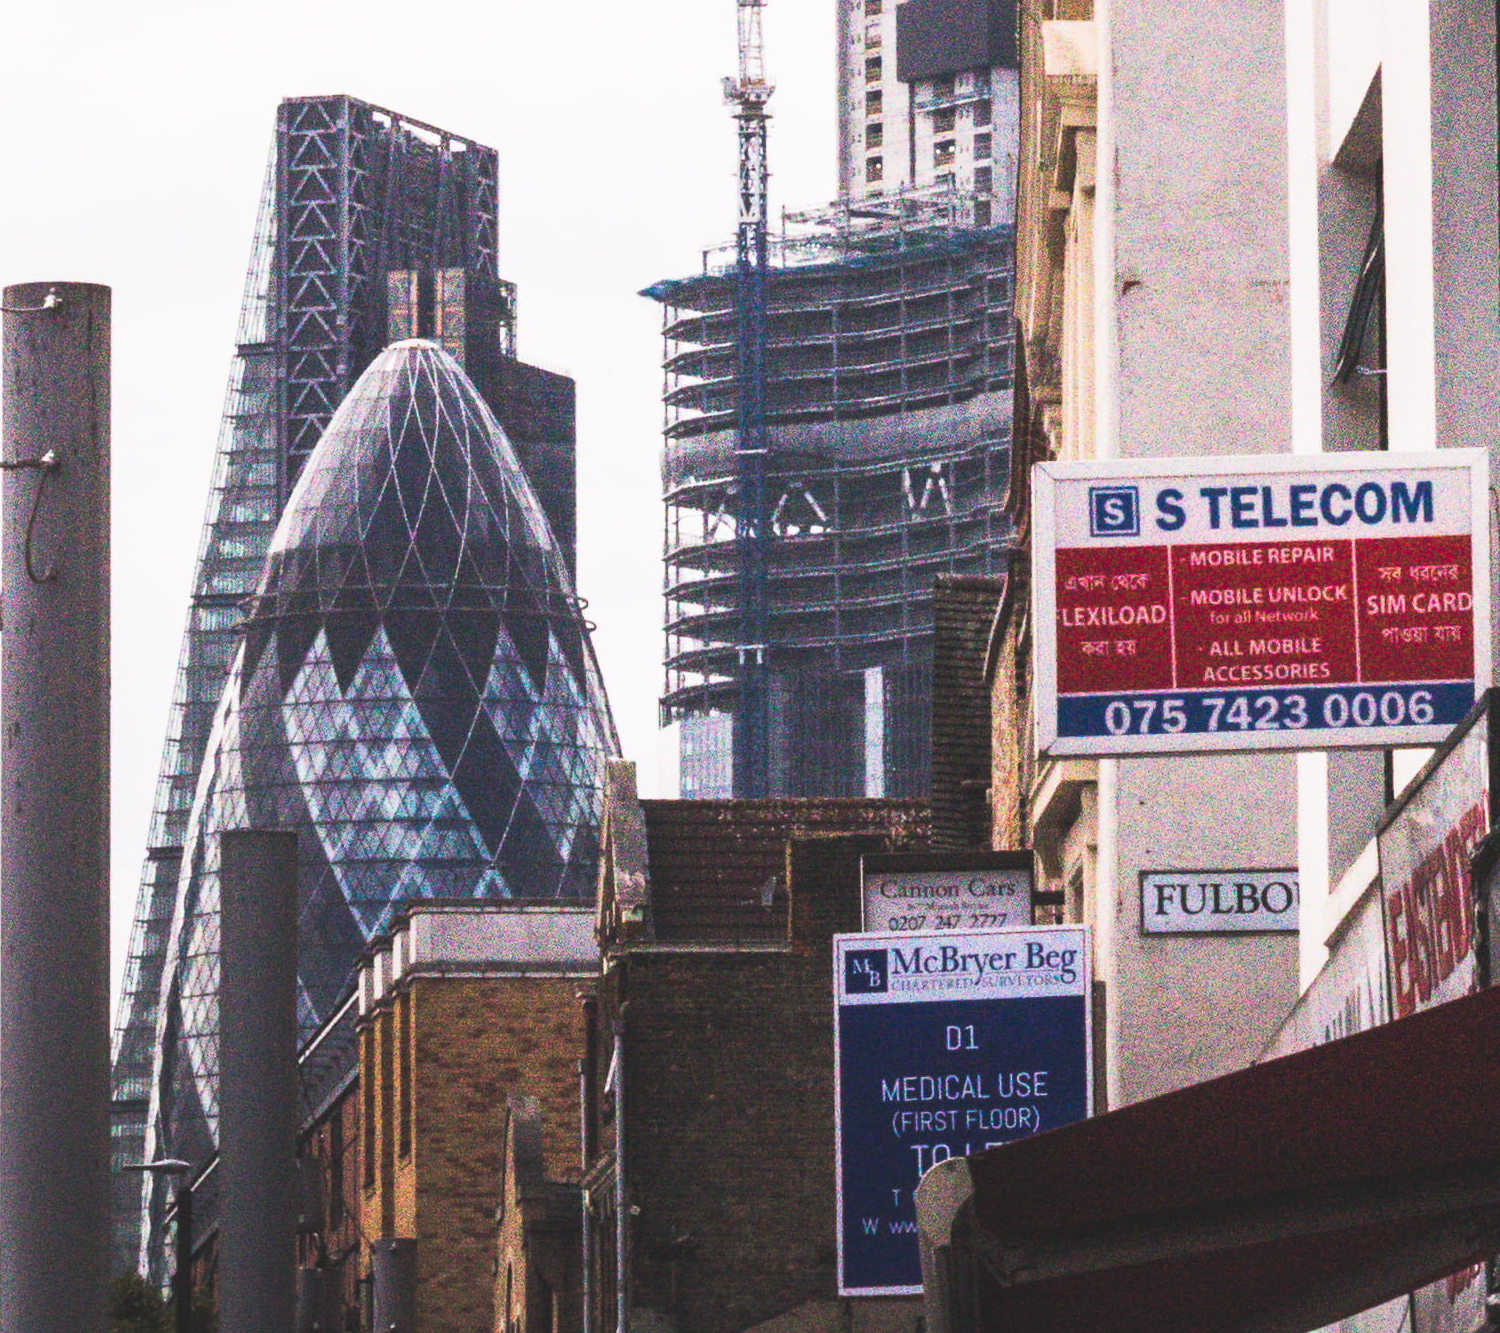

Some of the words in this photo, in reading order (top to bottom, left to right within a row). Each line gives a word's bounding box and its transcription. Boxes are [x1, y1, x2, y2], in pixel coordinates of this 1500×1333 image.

[1103, 497, 1126, 526] S
[1155, 487, 1187, 531] S
[1200, 481, 1434, 529] TELECOM
[1190, 549, 1263, 566] MOBILE
[1268, 547, 1335, 564] REPAIR
[1190, 588, 1264, 606] MOBILE
[1268, 584, 1348, 603] UNLOCK
[1366, 594, 1406, 615] SIM
[1412, 592, 1474, 614] CARD
[1210, 610, 1231, 624] for
[1235, 609, 1251, 623] all
[1255, 607, 1319, 623] Network
[1209, 640, 1244, 656] ALL
[1250, 637, 1323, 655] MOBILE
[1204, 662, 1331, 681] ACCESSORIES
[1104, 699, 1187, 735] 075
[1202, 694, 1309, 732] 7423
[1322, 690, 1435, 728] 0006
[968, 877, 1016, 897] Cars
[1153, 880, 1300, 915] FULBO
[891, 945, 1016, 985] McBryer
[1025, 942, 1077, 984] Beg
[946, 1024, 980, 1051] D1
[881, 1074, 990, 1102] MEDICAL
[998, 1071, 1049, 1099] USE
[892, 1110, 959, 1138] (FIRST
[965, 1105, 1041, 1133] FLOOR)
[862, 1217, 880, 1234] W
